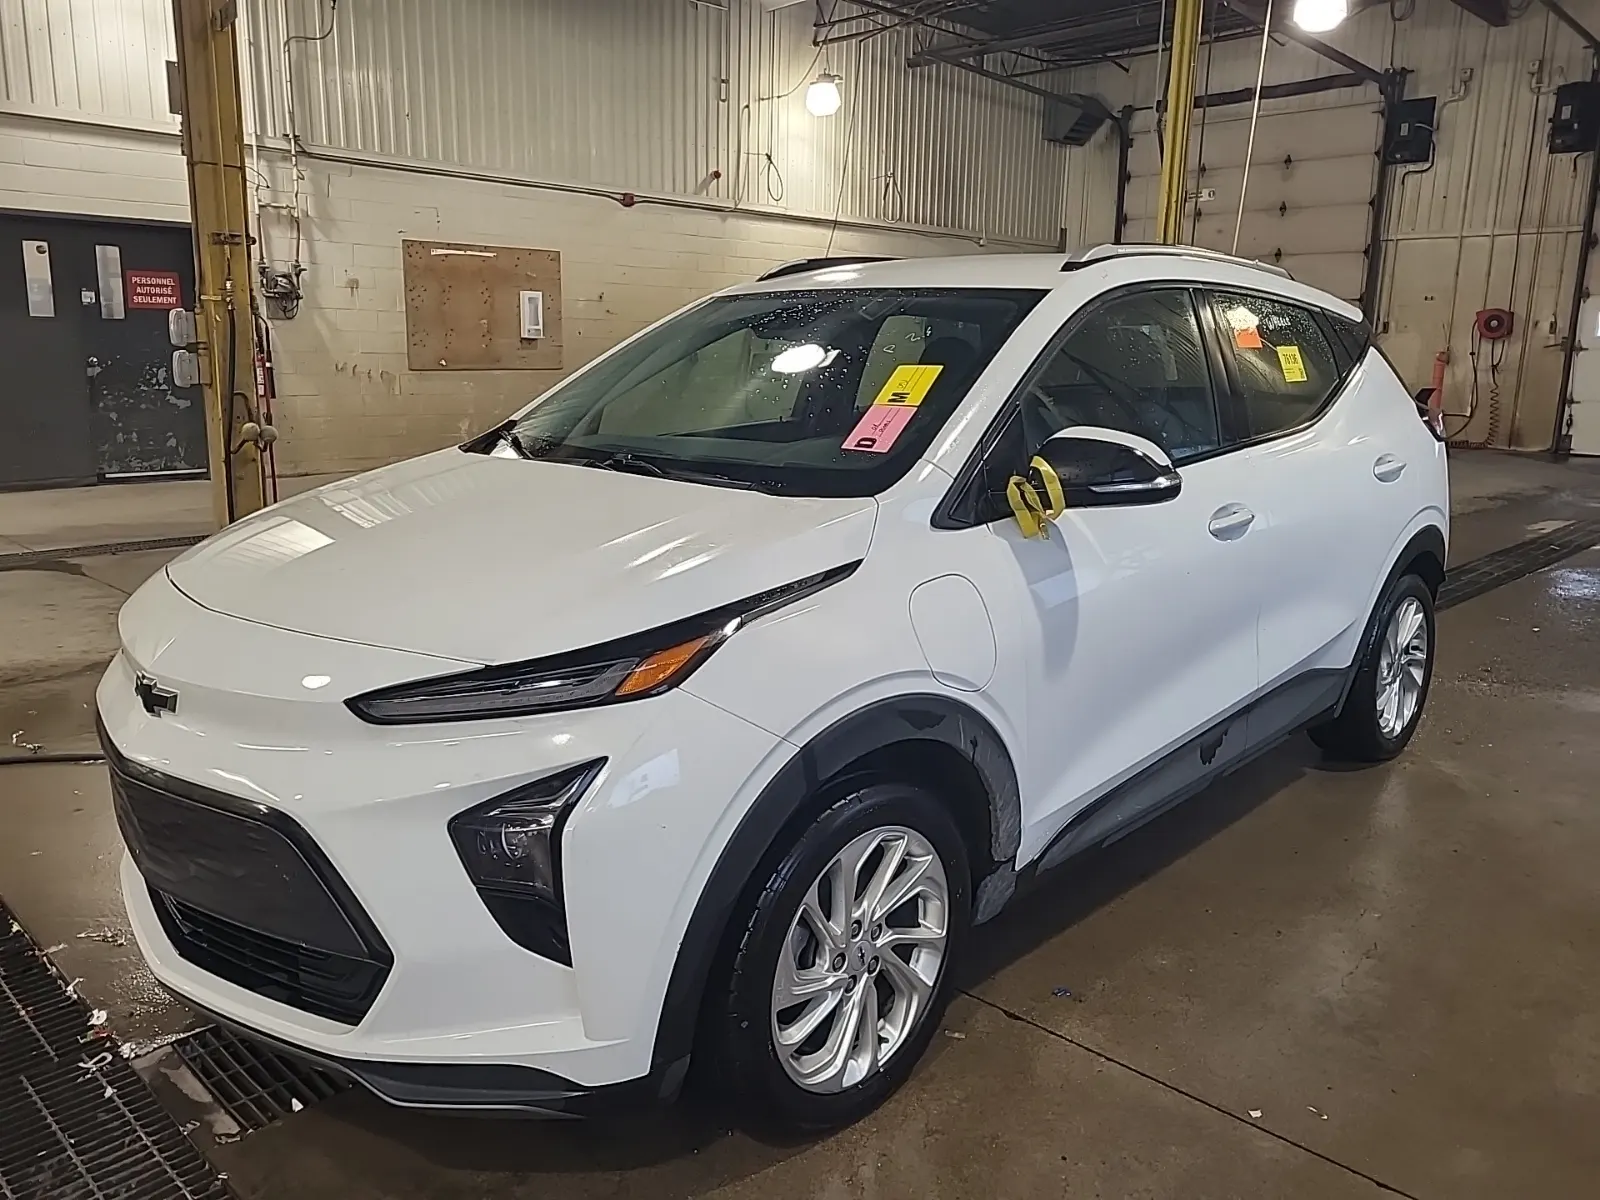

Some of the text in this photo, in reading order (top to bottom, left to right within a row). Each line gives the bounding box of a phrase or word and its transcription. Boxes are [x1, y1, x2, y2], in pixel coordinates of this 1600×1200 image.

[131, 277, 175, 285] PERSONNEL
[136, 286, 172, 294] AUTORISÉ
[133, 296, 176, 304] SEULEMENT
[887, 392, 910, 403] M
[854, 437, 877, 448] D
